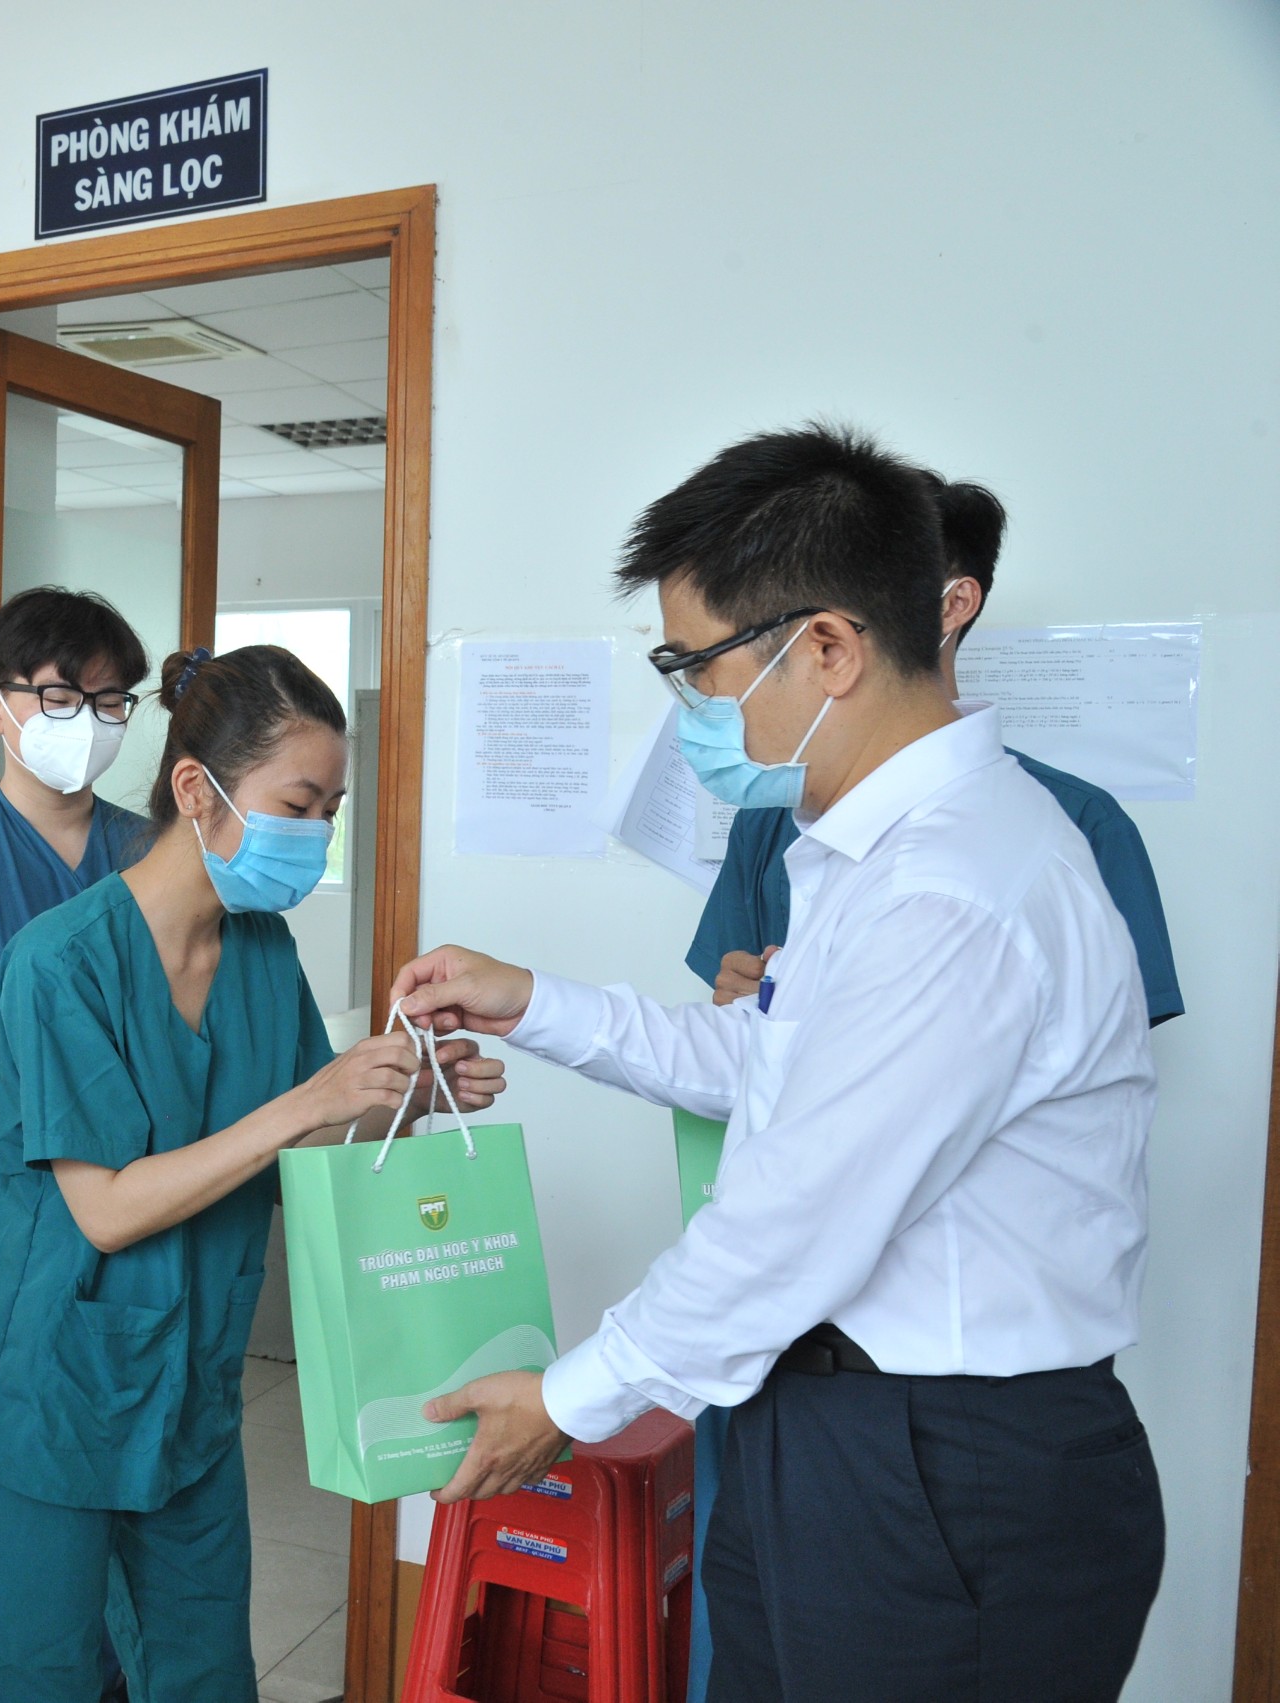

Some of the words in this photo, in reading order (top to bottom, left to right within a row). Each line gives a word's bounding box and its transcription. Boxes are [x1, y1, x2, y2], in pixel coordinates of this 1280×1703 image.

[51, 118, 149, 167] PHÒNG
[159, 94, 251, 146] KHÁM
[74, 167, 152, 212] SÀNG
[162, 154, 223, 199] LỌC
[471, 1238, 480, 1252] Y
[483, 1232, 518, 1251] KHOA
[381, 1270, 420, 1290] PHẠM
[462, 1256, 504, 1276] THẠCH
